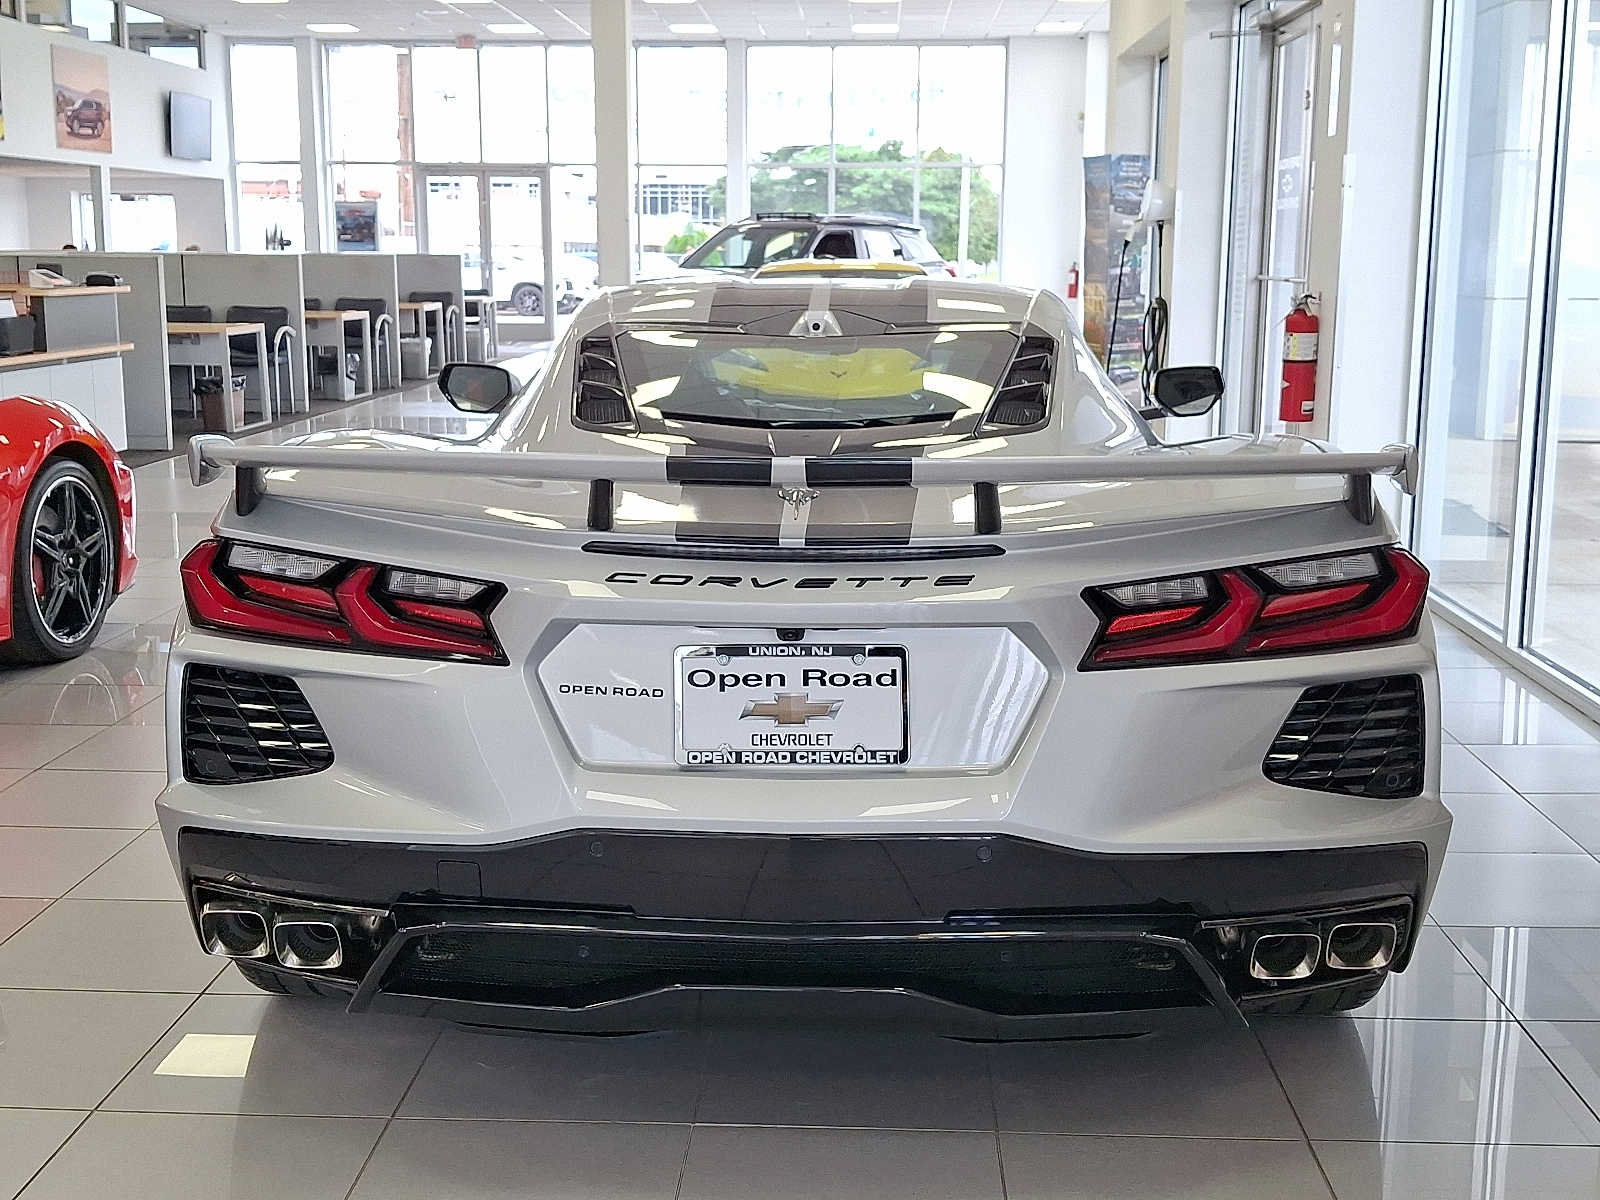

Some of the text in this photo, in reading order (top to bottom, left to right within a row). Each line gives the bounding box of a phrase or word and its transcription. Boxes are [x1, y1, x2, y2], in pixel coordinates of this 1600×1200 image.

[605, 572, 975, 589] CORVETTE
[811, 646, 833, 656] NJ
[687, 668, 897, 692] Open Road
[559, 684, 664, 698] OPEN ROAD
[751, 733, 833, 747] CHEVROLET
[688, 751, 897, 764] OPEN ROAD CHEVROLET
